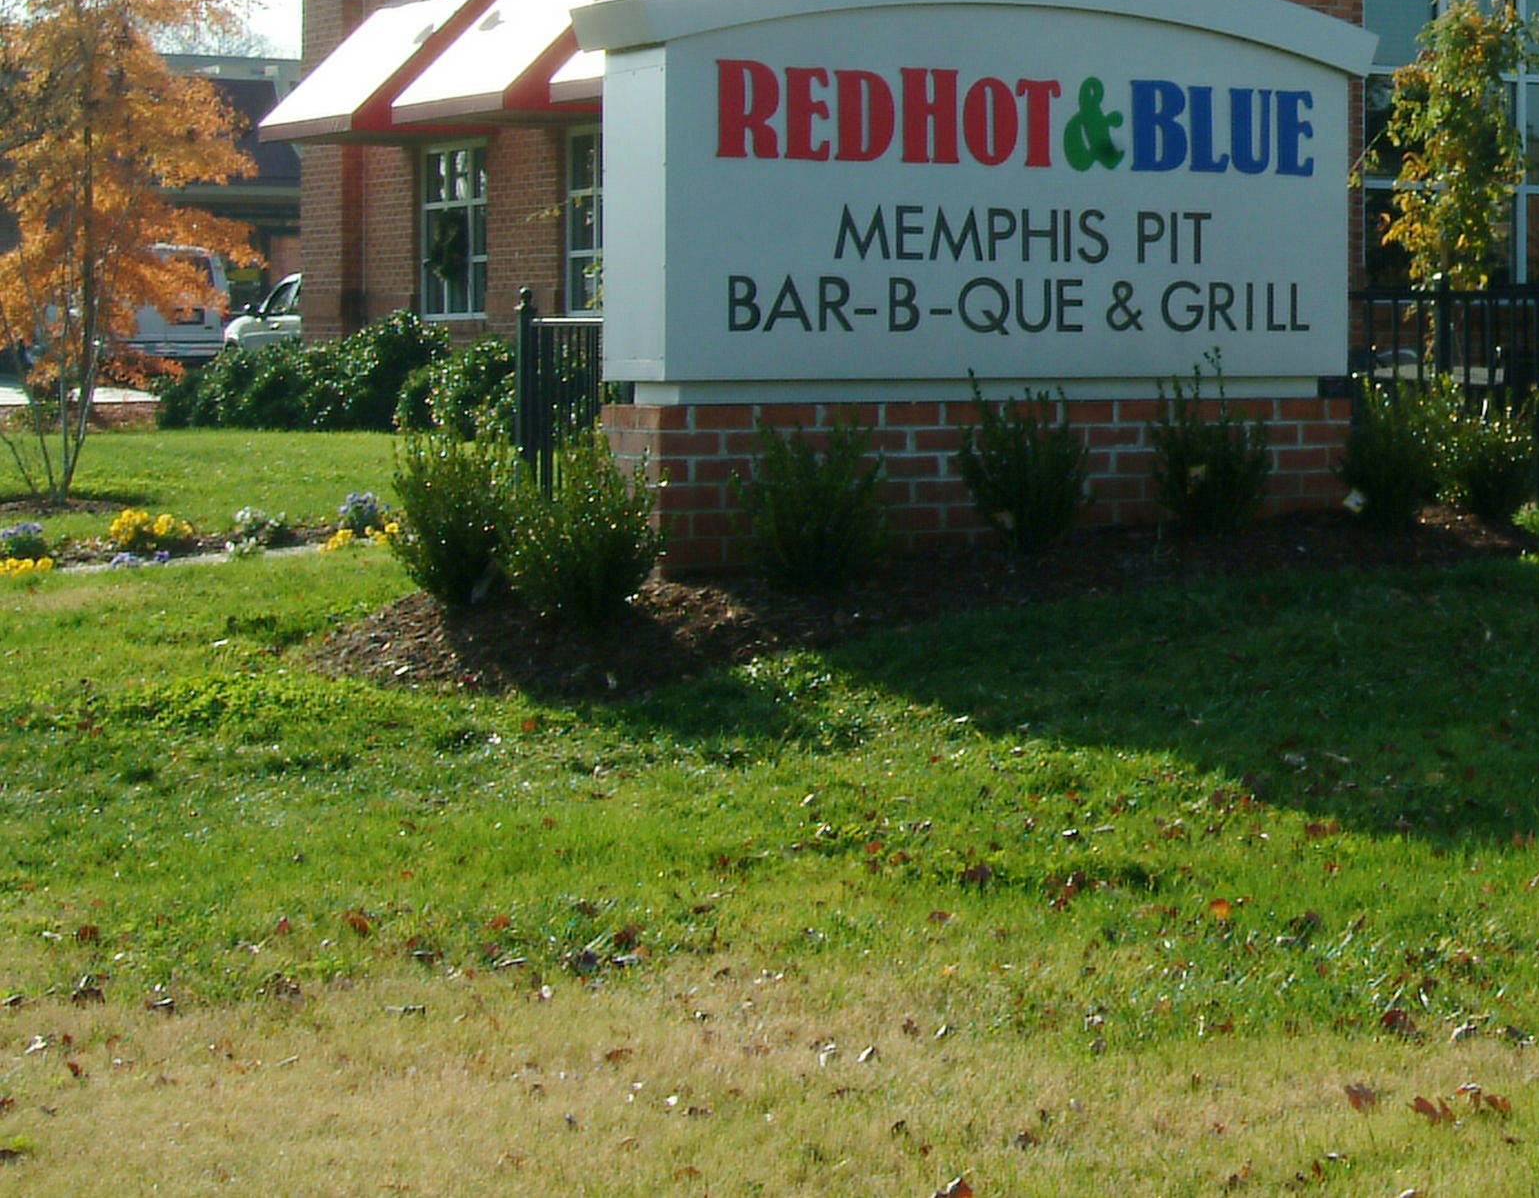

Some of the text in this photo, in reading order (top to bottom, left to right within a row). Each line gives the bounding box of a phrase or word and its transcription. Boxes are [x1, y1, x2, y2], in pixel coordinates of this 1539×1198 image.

[1063, 76, 1123, 173] &
[1130, 78, 1315, 178] BLUE
[834, 204, 1213, 264] MEMPHIS PIT
[727, 275, 1310, 336] BAR-B-QUE & GRILL
